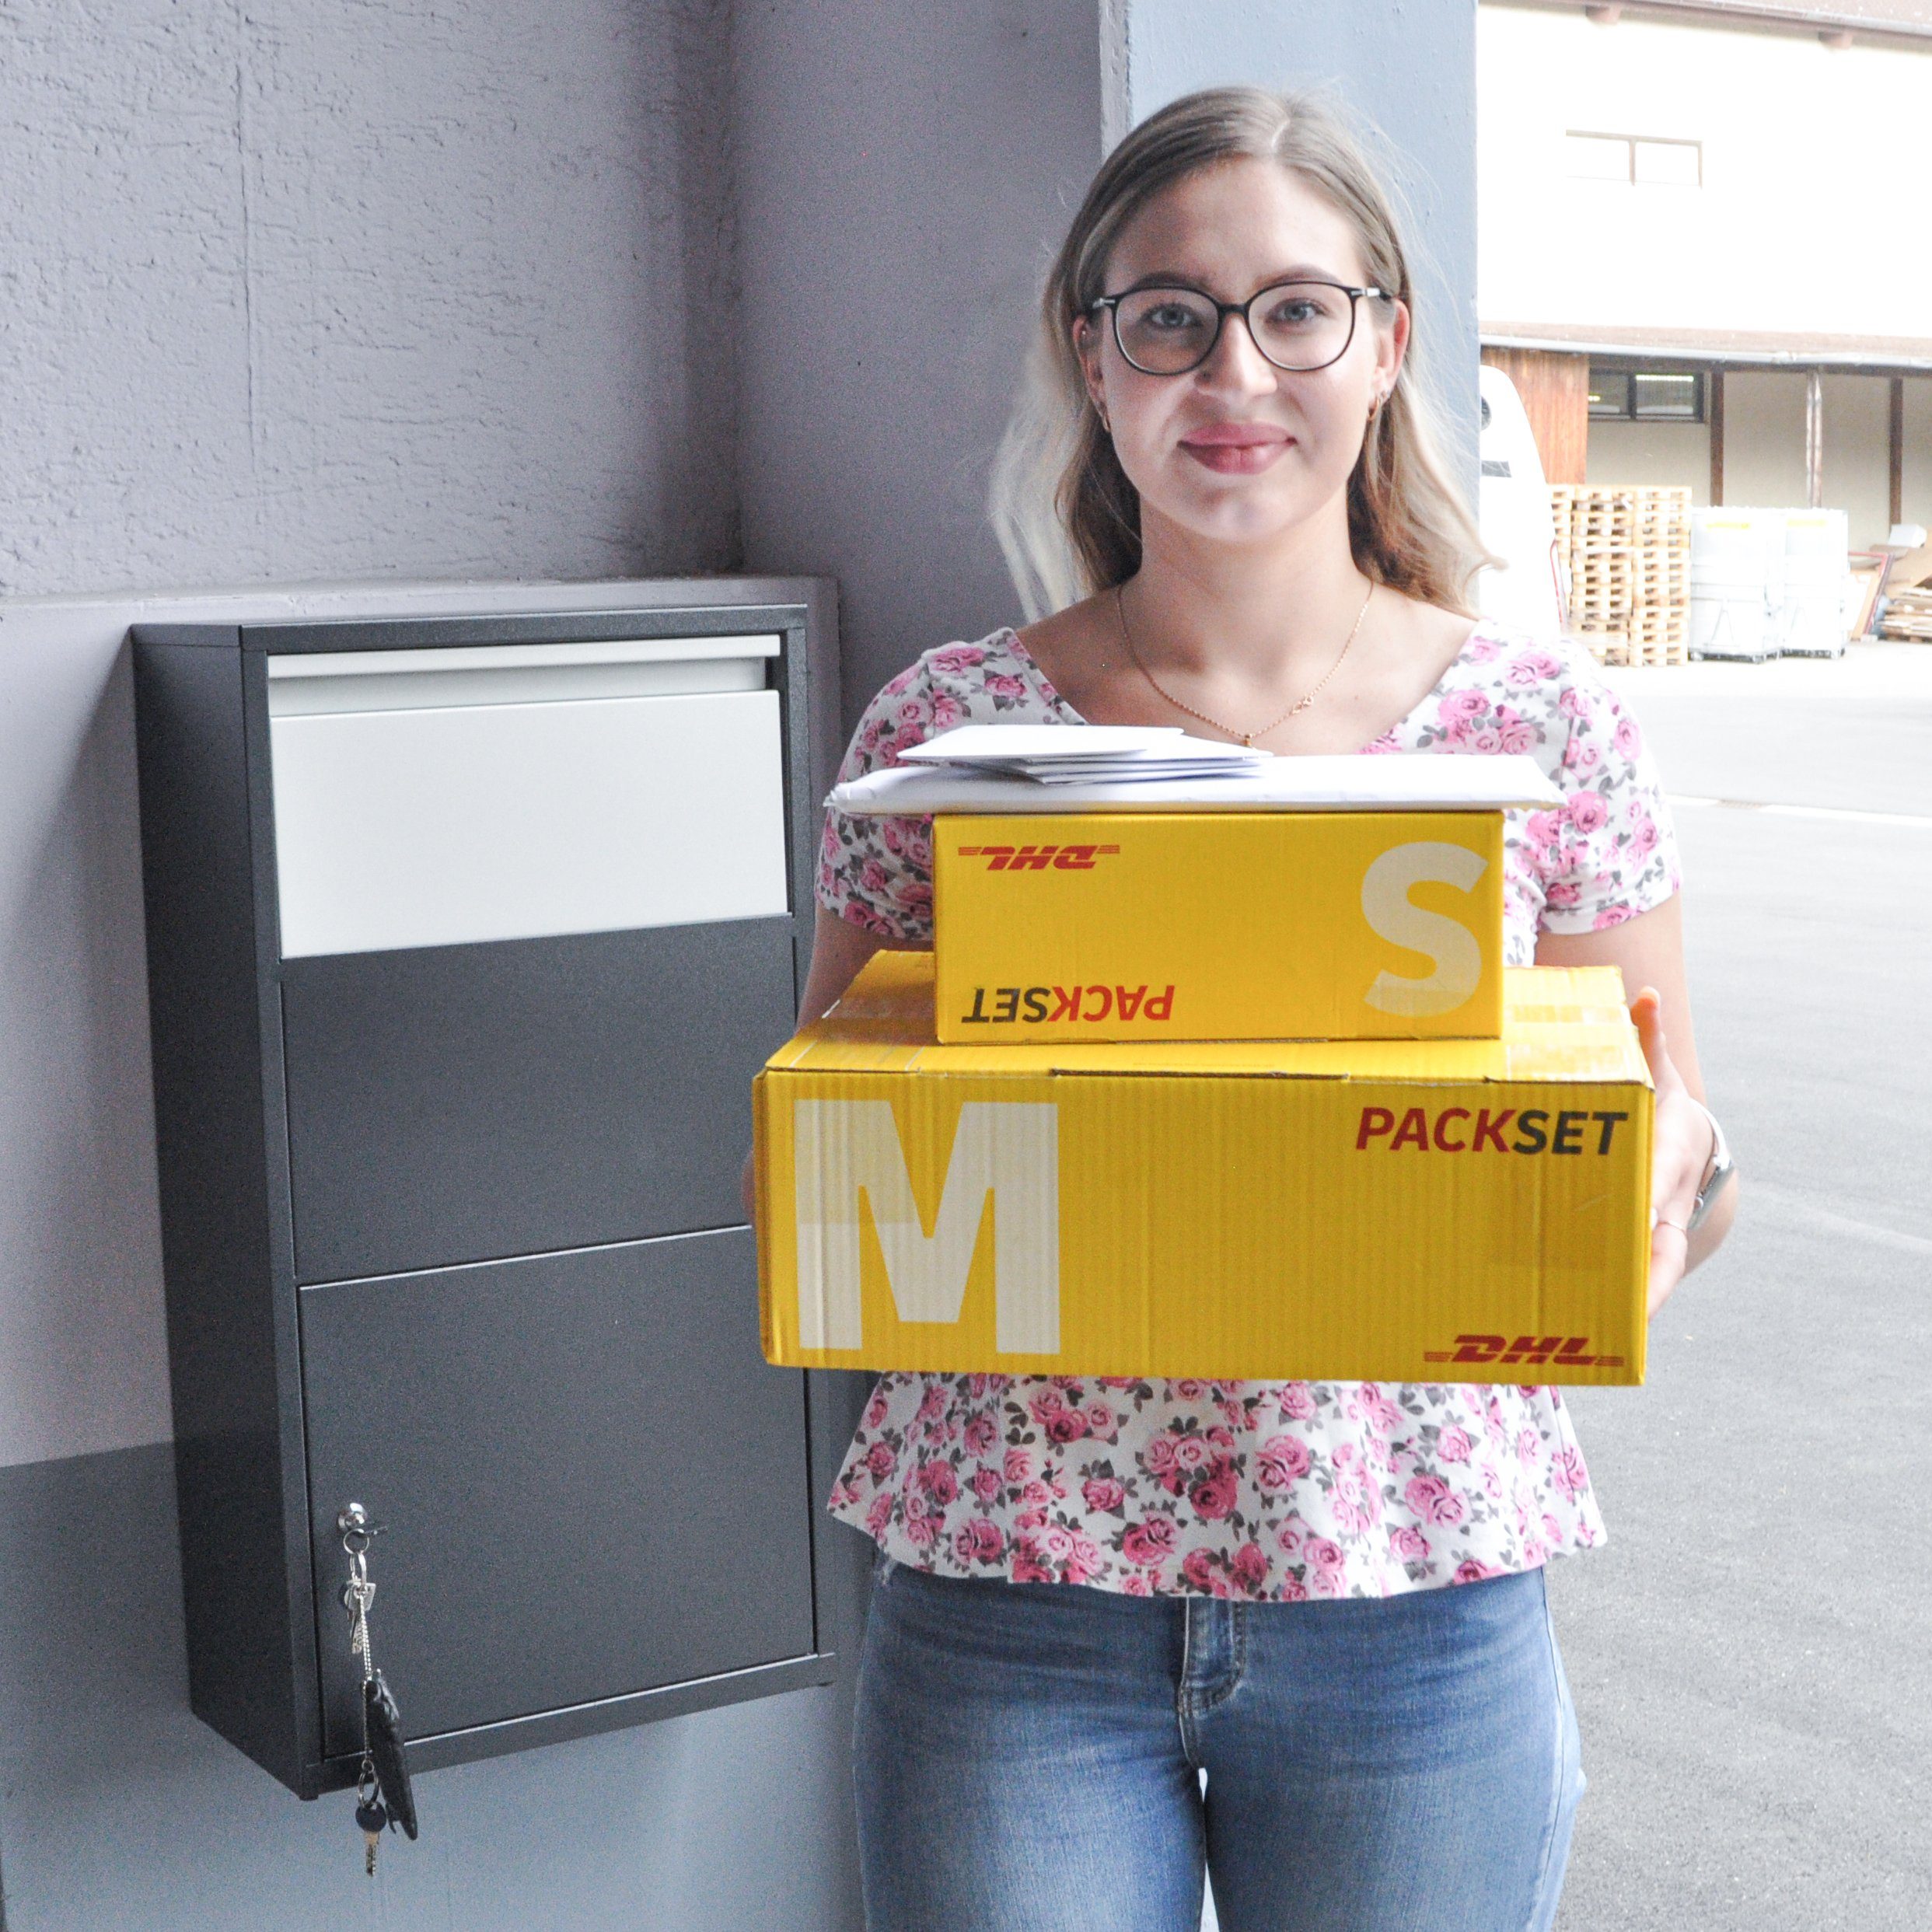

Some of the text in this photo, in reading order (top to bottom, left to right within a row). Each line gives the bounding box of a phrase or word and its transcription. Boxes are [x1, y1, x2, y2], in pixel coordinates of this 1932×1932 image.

[980, 845, 1098, 871] DHL
[1361, 840, 1488, 1017] S
[961, 984, 1175, 1023] PACKSET
[1356, 1107, 1629, 1155] PACKSET
[794, 1099, 1060, 1354] M
[1451, 1334, 1595, 1364] DHL
